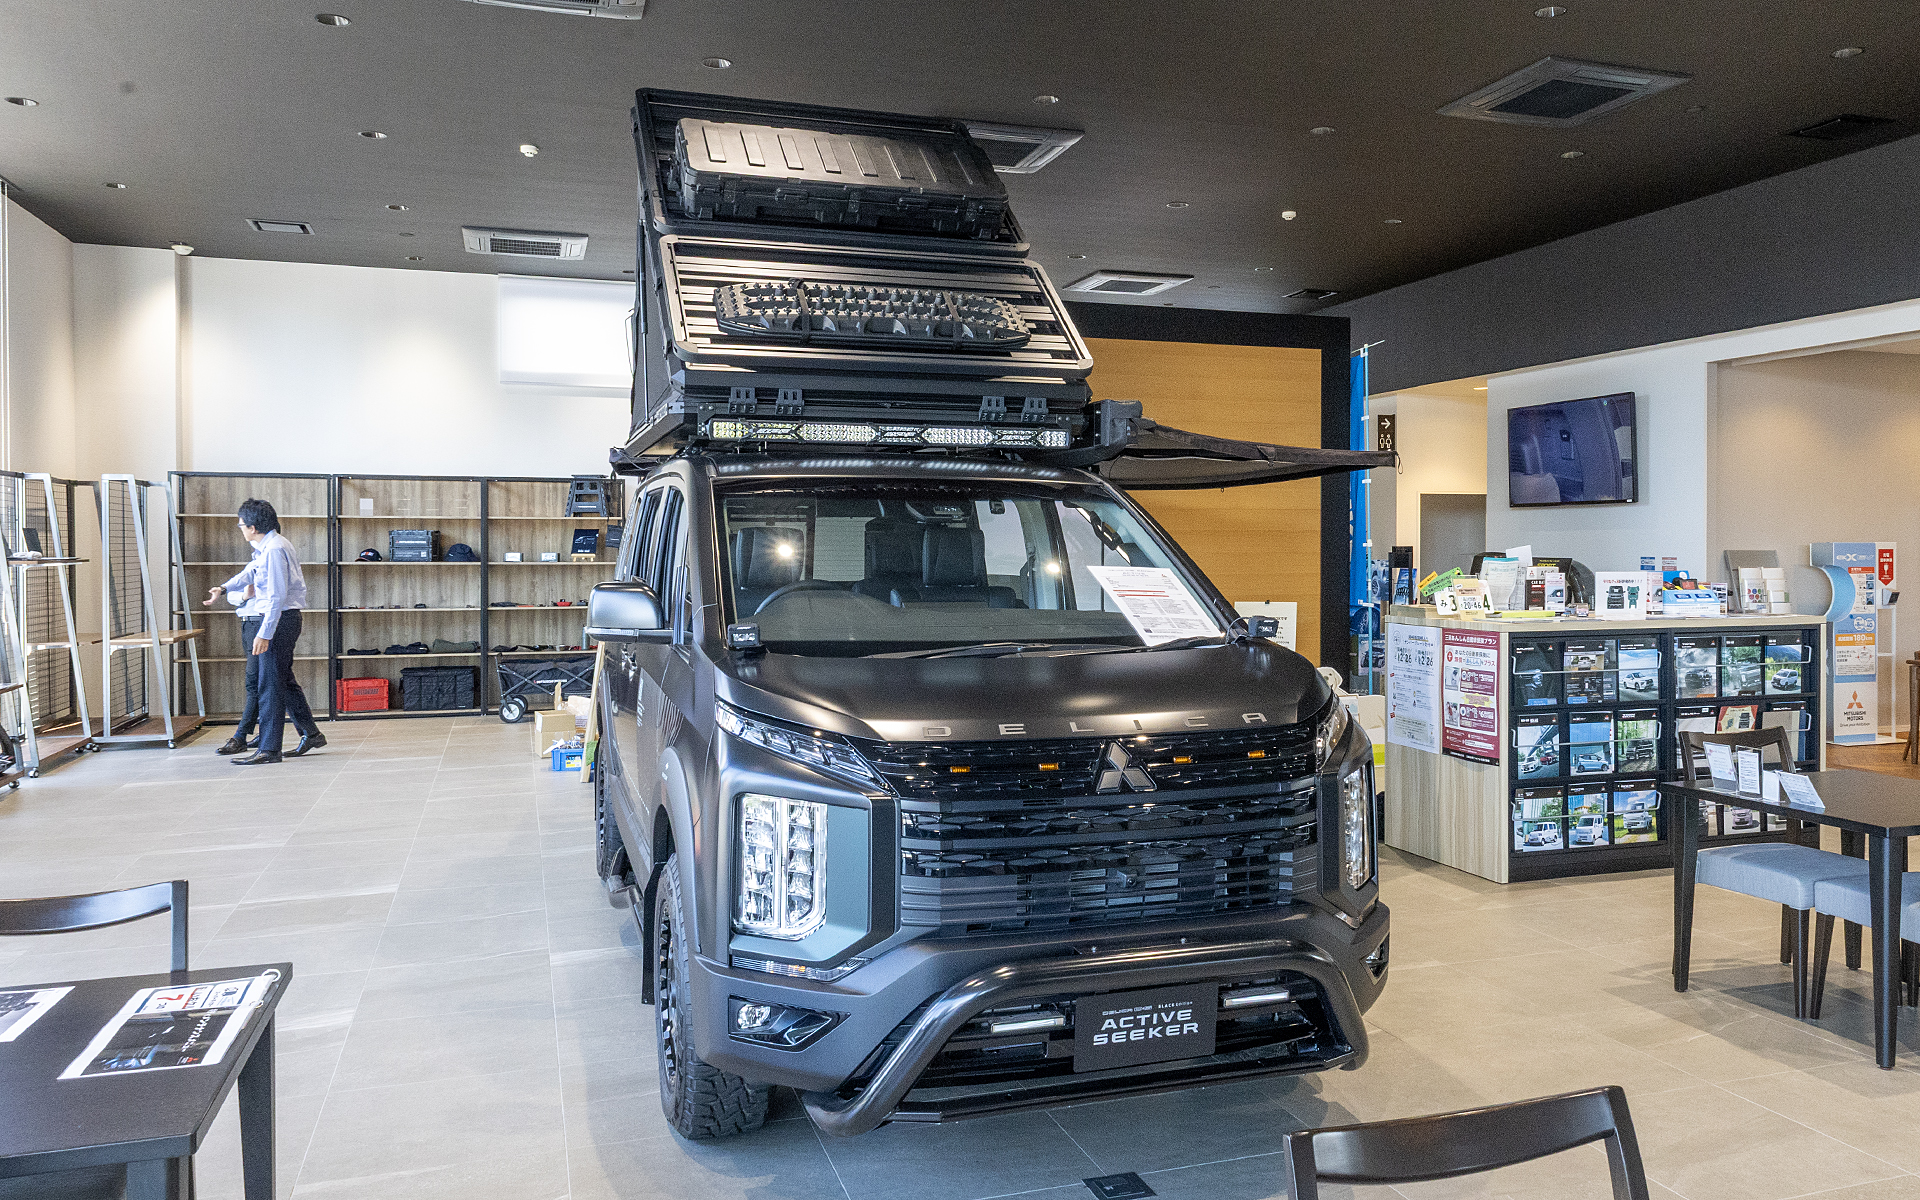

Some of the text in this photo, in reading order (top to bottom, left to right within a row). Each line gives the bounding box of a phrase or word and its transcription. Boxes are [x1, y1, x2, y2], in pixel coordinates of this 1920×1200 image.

[923, 712, 1268, 738] DELICA
[1101, 1009, 1192, 1030] ACTIVE
[1093, 1022, 1199, 1046] SEEKER
